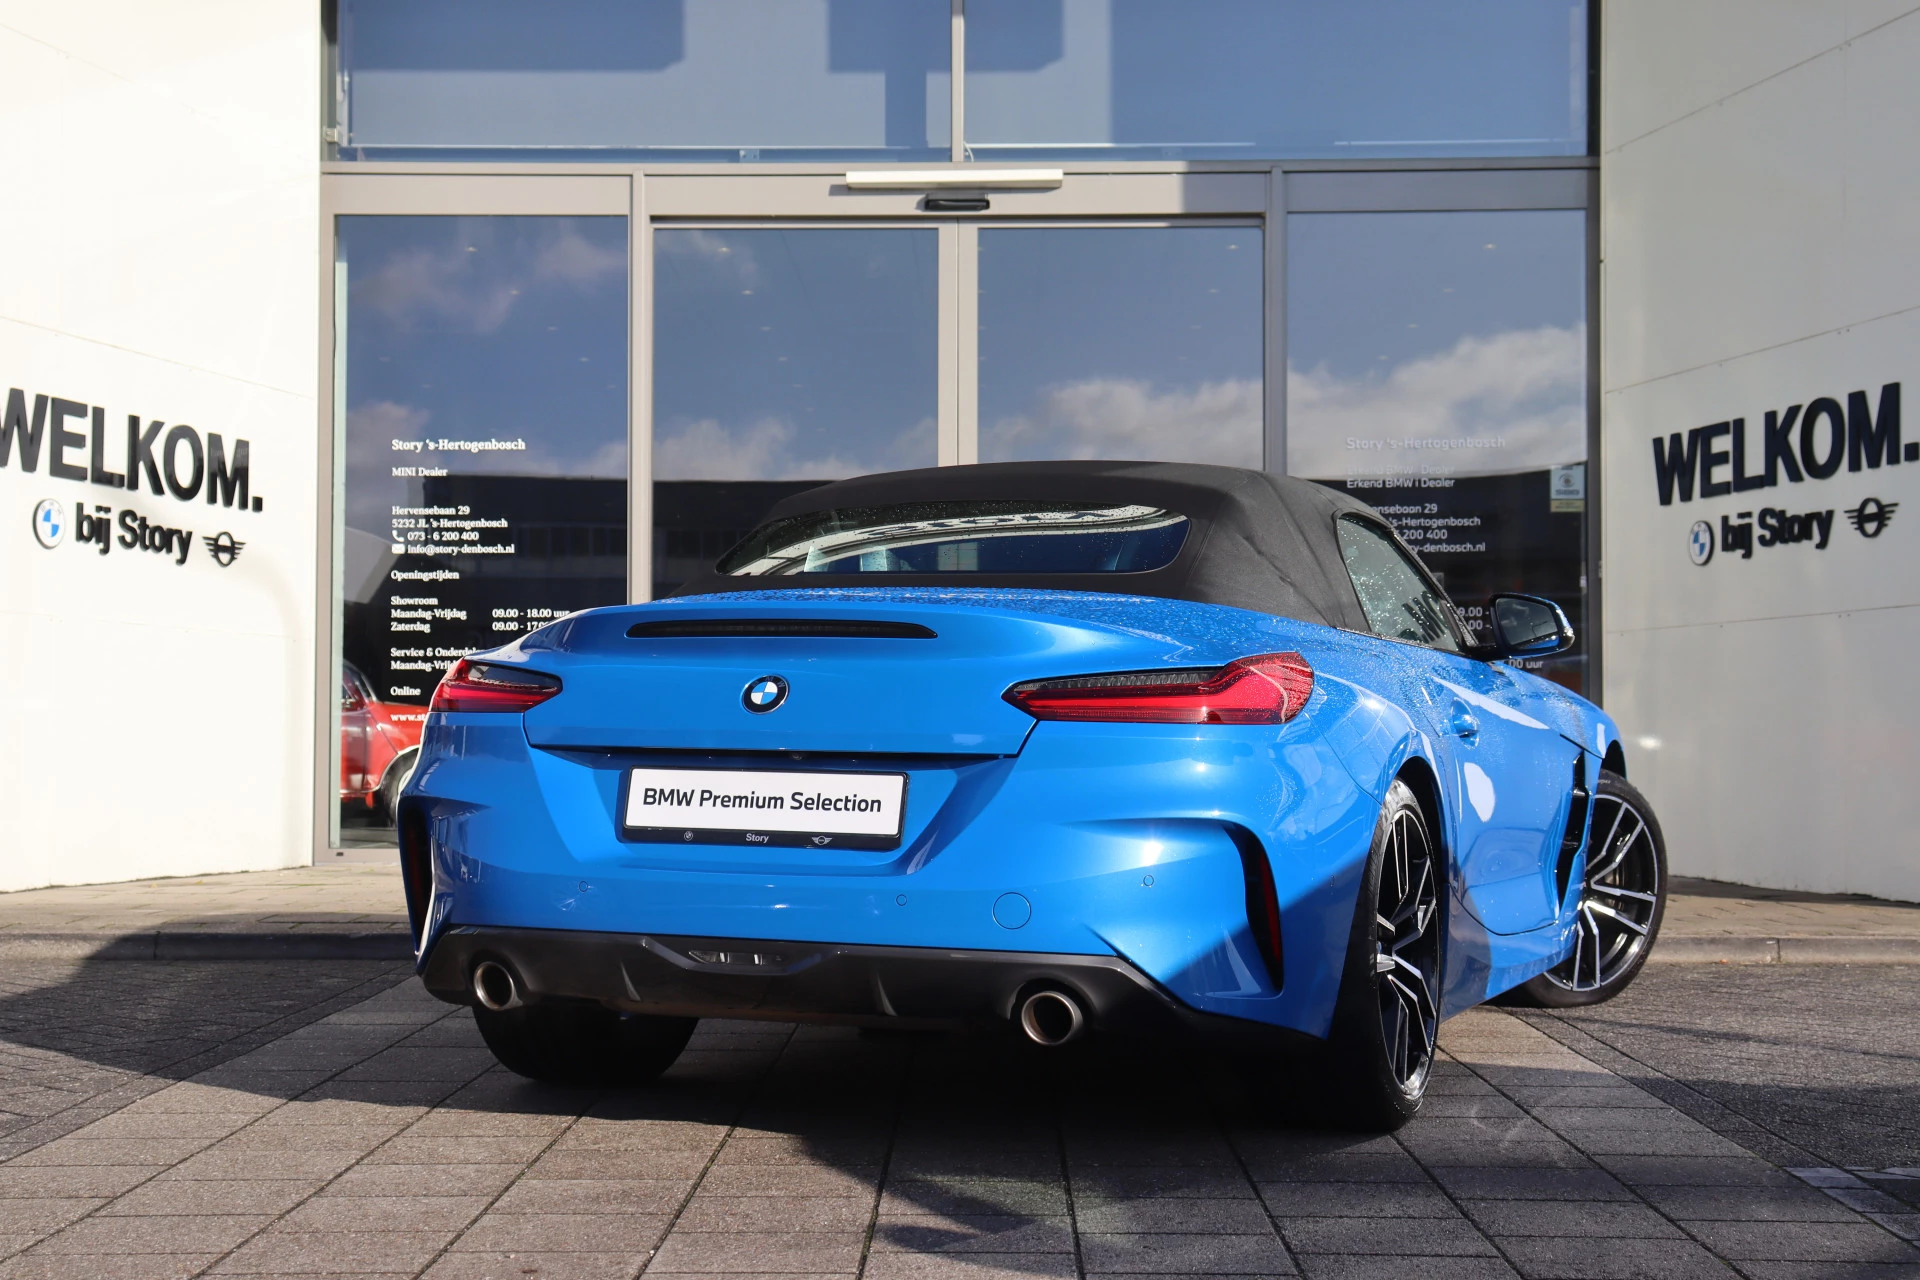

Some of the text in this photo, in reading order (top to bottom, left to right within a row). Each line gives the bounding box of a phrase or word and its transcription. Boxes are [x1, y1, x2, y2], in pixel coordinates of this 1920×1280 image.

[391, 439, 526, 453] Story 's-Hertogenbosch
[1347, 436, 1506, 450] Story 's-Hertogenbosch
[1652, 382, 1919, 506] WELKOM.
[0, 387, 263, 512] WELKOM.
[391, 467, 448, 477] MINI Dealer
[1347, 478, 1383, 488] Erkend
[1385, 478, 1413, 488] BMW
[1420, 477, 1455, 488] Dealer
[391, 506, 470, 515] Hervensebaan 29
[1423, 503, 1438, 514] 29
[391, 518, 508, 530] 5232 JL 's-Hertogenbosch
[1389, 516, 1481, 528] 's-Hertogenbosch
[75, 502, 193, 566] bij Story
[407, 531, 426, 541] 073
[432, 531, 440, 541] 6
[441, 531, 459, 541] 200
[460, 531, 479, 541] 400
[1402, 529, 1448, 540] 200 400
[1721, 507, 1835, 560] bij Story
[407, 544, 515, 555] info@story-denbosch.nl
[391, 570, 460, 582] Openingstijden
[390, 596, 438, 605] Showroom
[390, 608, 467, 620] Maandag-Vrijdag
[492, 609, 519, 618] 09.00
[526, 609, 552, 618] 18.00
[1458, 607, 1483, 617] 9.00
[390, 621, 431, 633] Zaterdag
[492, 621, 519, 631] 09.00
[390, 647, 424, 657] Service
[426, 647, 434, 657] &
[390, 686, 421, 696] Online
[643, 788, 882, 813] BMW Premium Selection
[745, 833, 769, 844] Story
